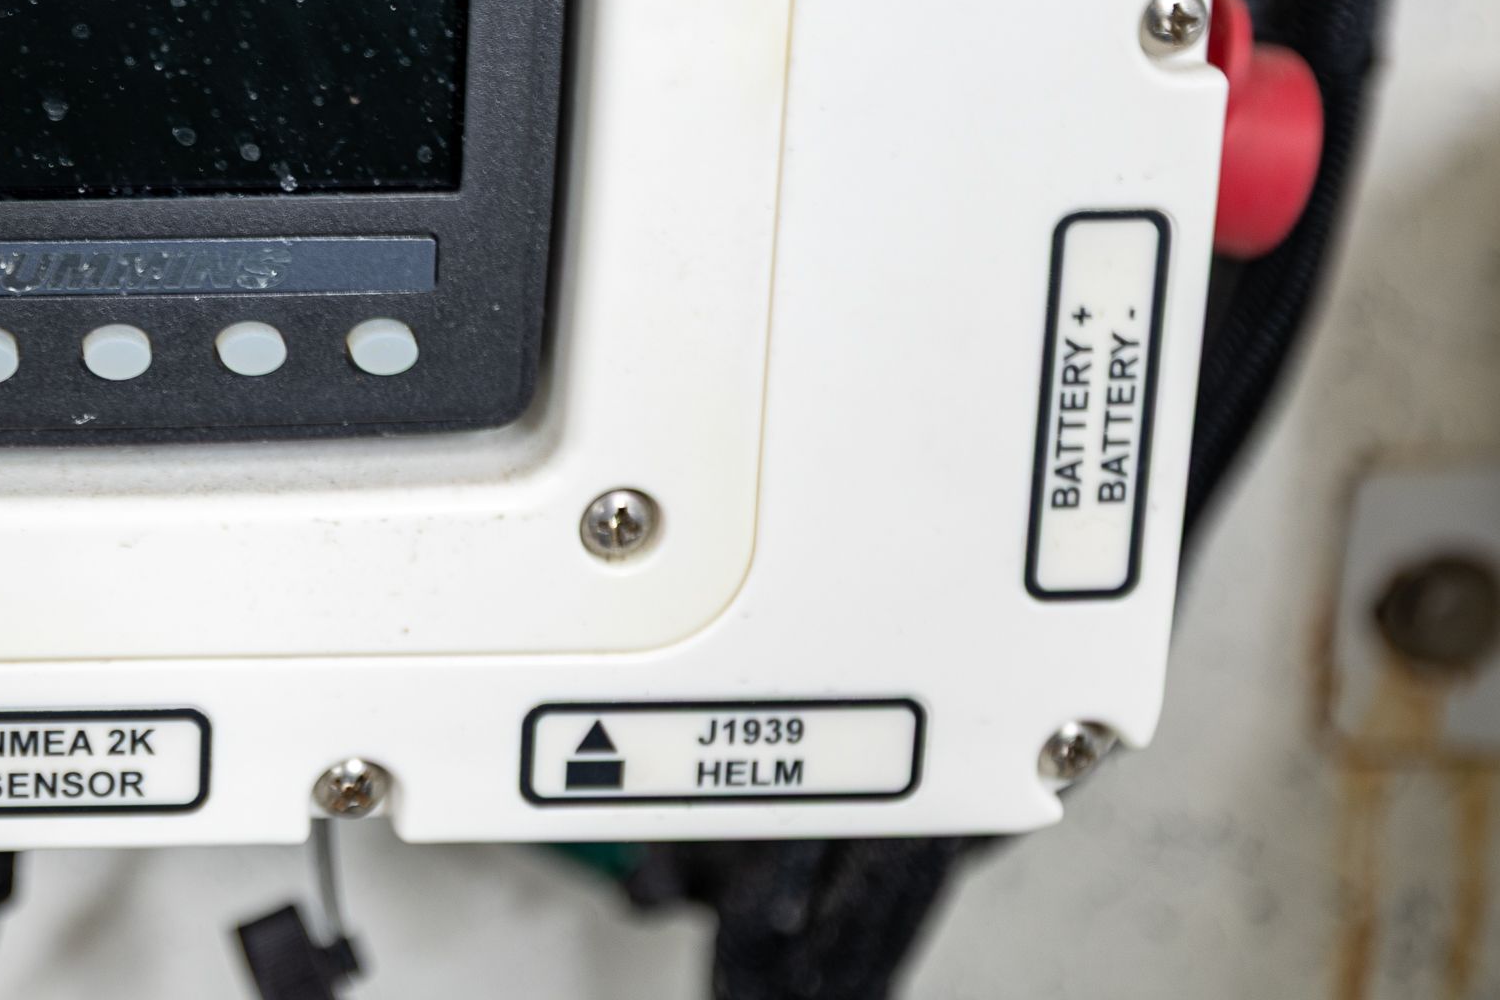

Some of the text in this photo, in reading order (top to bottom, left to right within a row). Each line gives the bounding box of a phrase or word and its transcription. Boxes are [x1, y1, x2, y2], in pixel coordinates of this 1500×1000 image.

[1050, 337, 1094, 510] BATTERY
[1097, 331, 1141, 505] BATTERY
[107, 728, 156, 756] 2K
[697, 717, 806, 746] J1939
[696, 759, 805, 788] HELM
